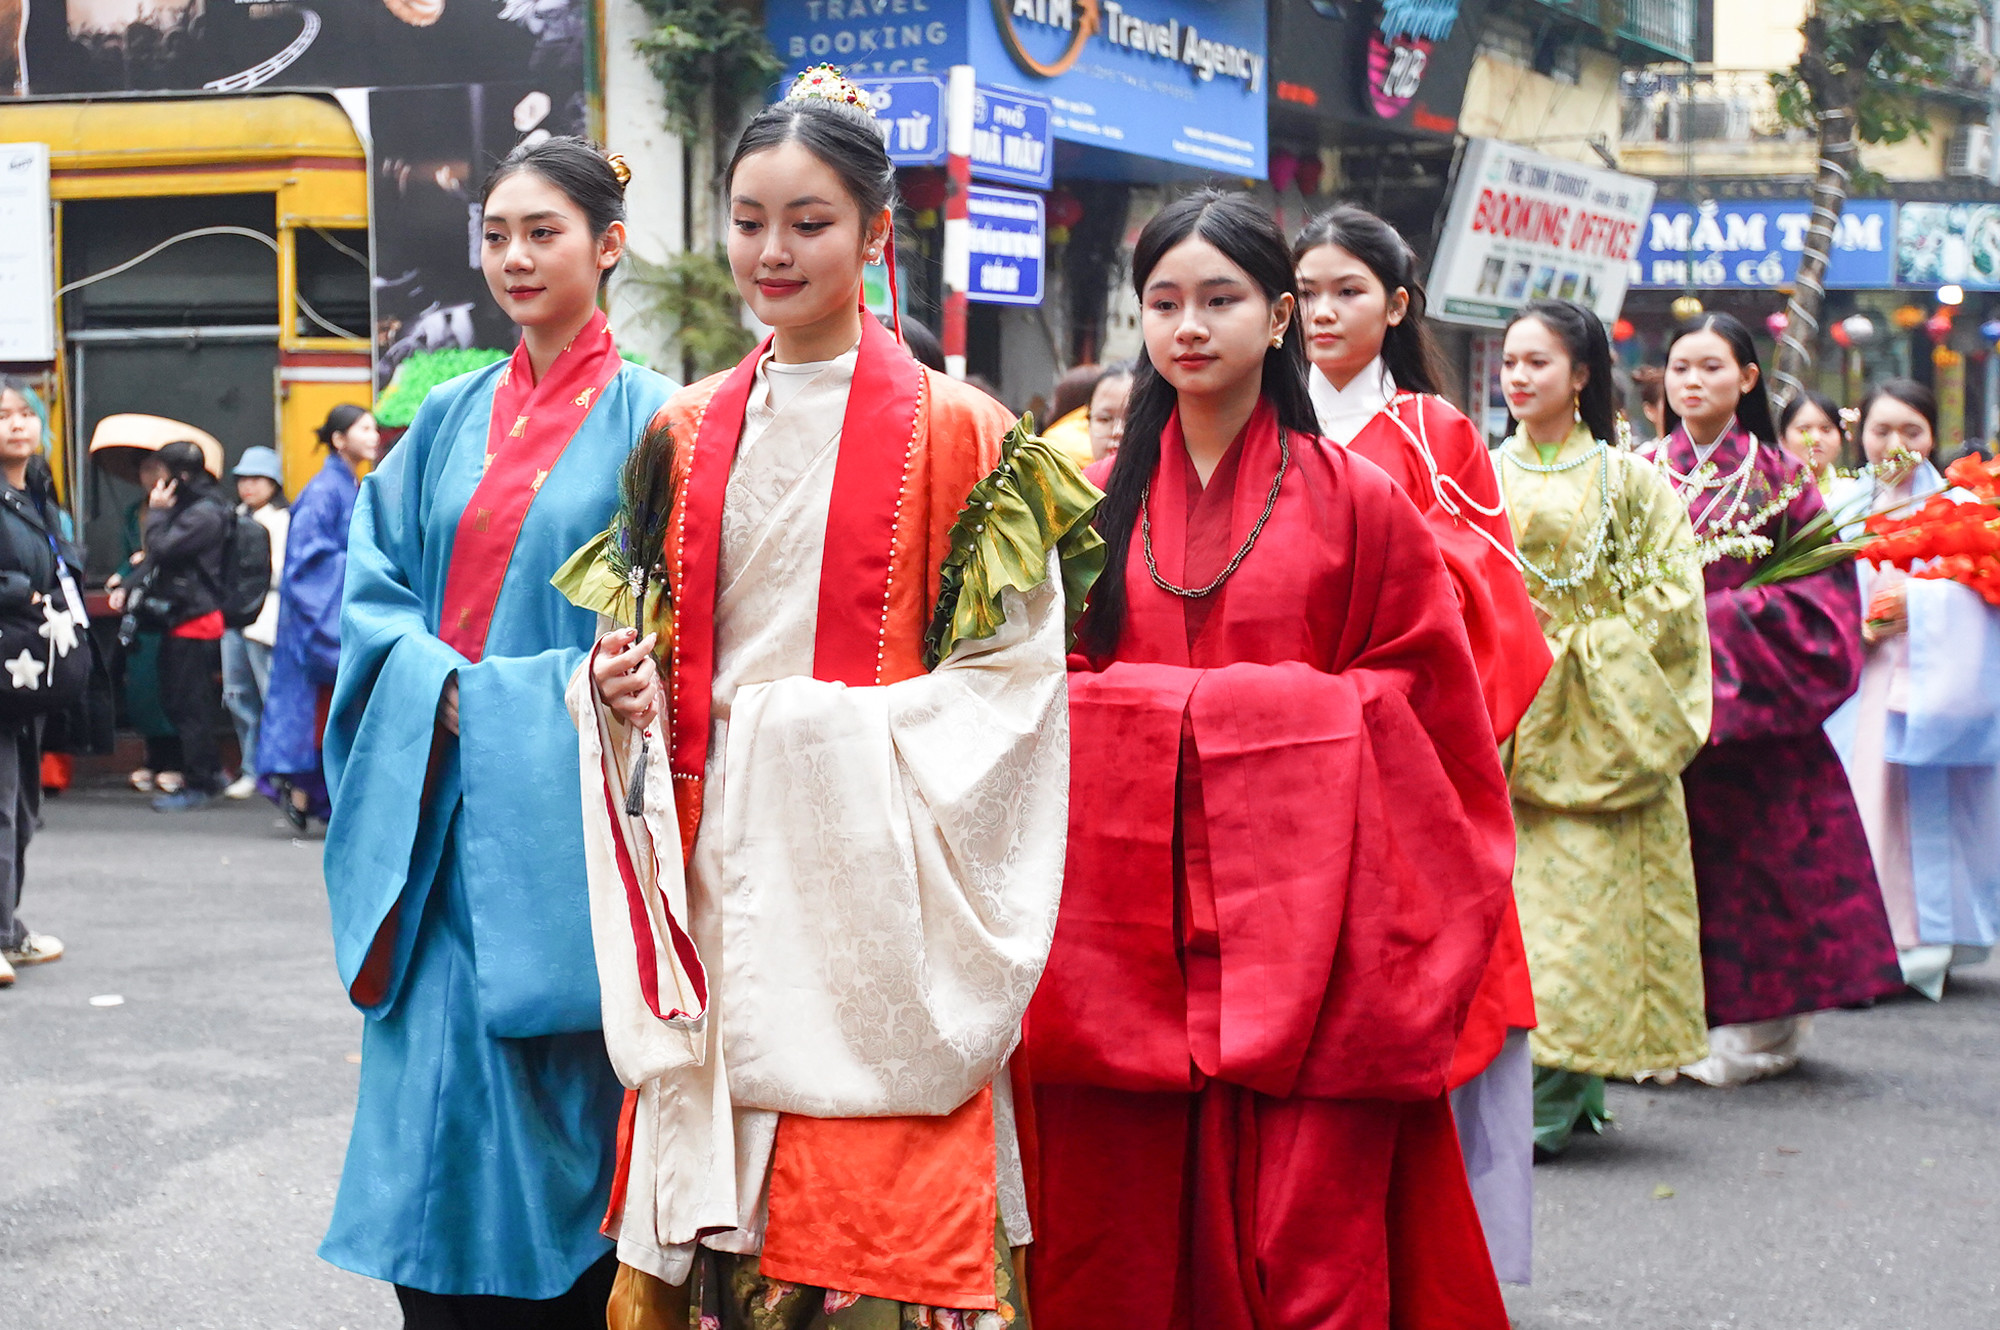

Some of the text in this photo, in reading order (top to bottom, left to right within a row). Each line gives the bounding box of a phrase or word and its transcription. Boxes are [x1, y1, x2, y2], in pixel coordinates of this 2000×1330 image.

[789, 22, 948, 58] BOOKING
[1104, 1, 1179, 61] Travel
[1182, 25, 1265, 94] Agency
[1472, 188, 1568, 247] BOOKING
[1570, 211, 1637, 260] OFFICE
